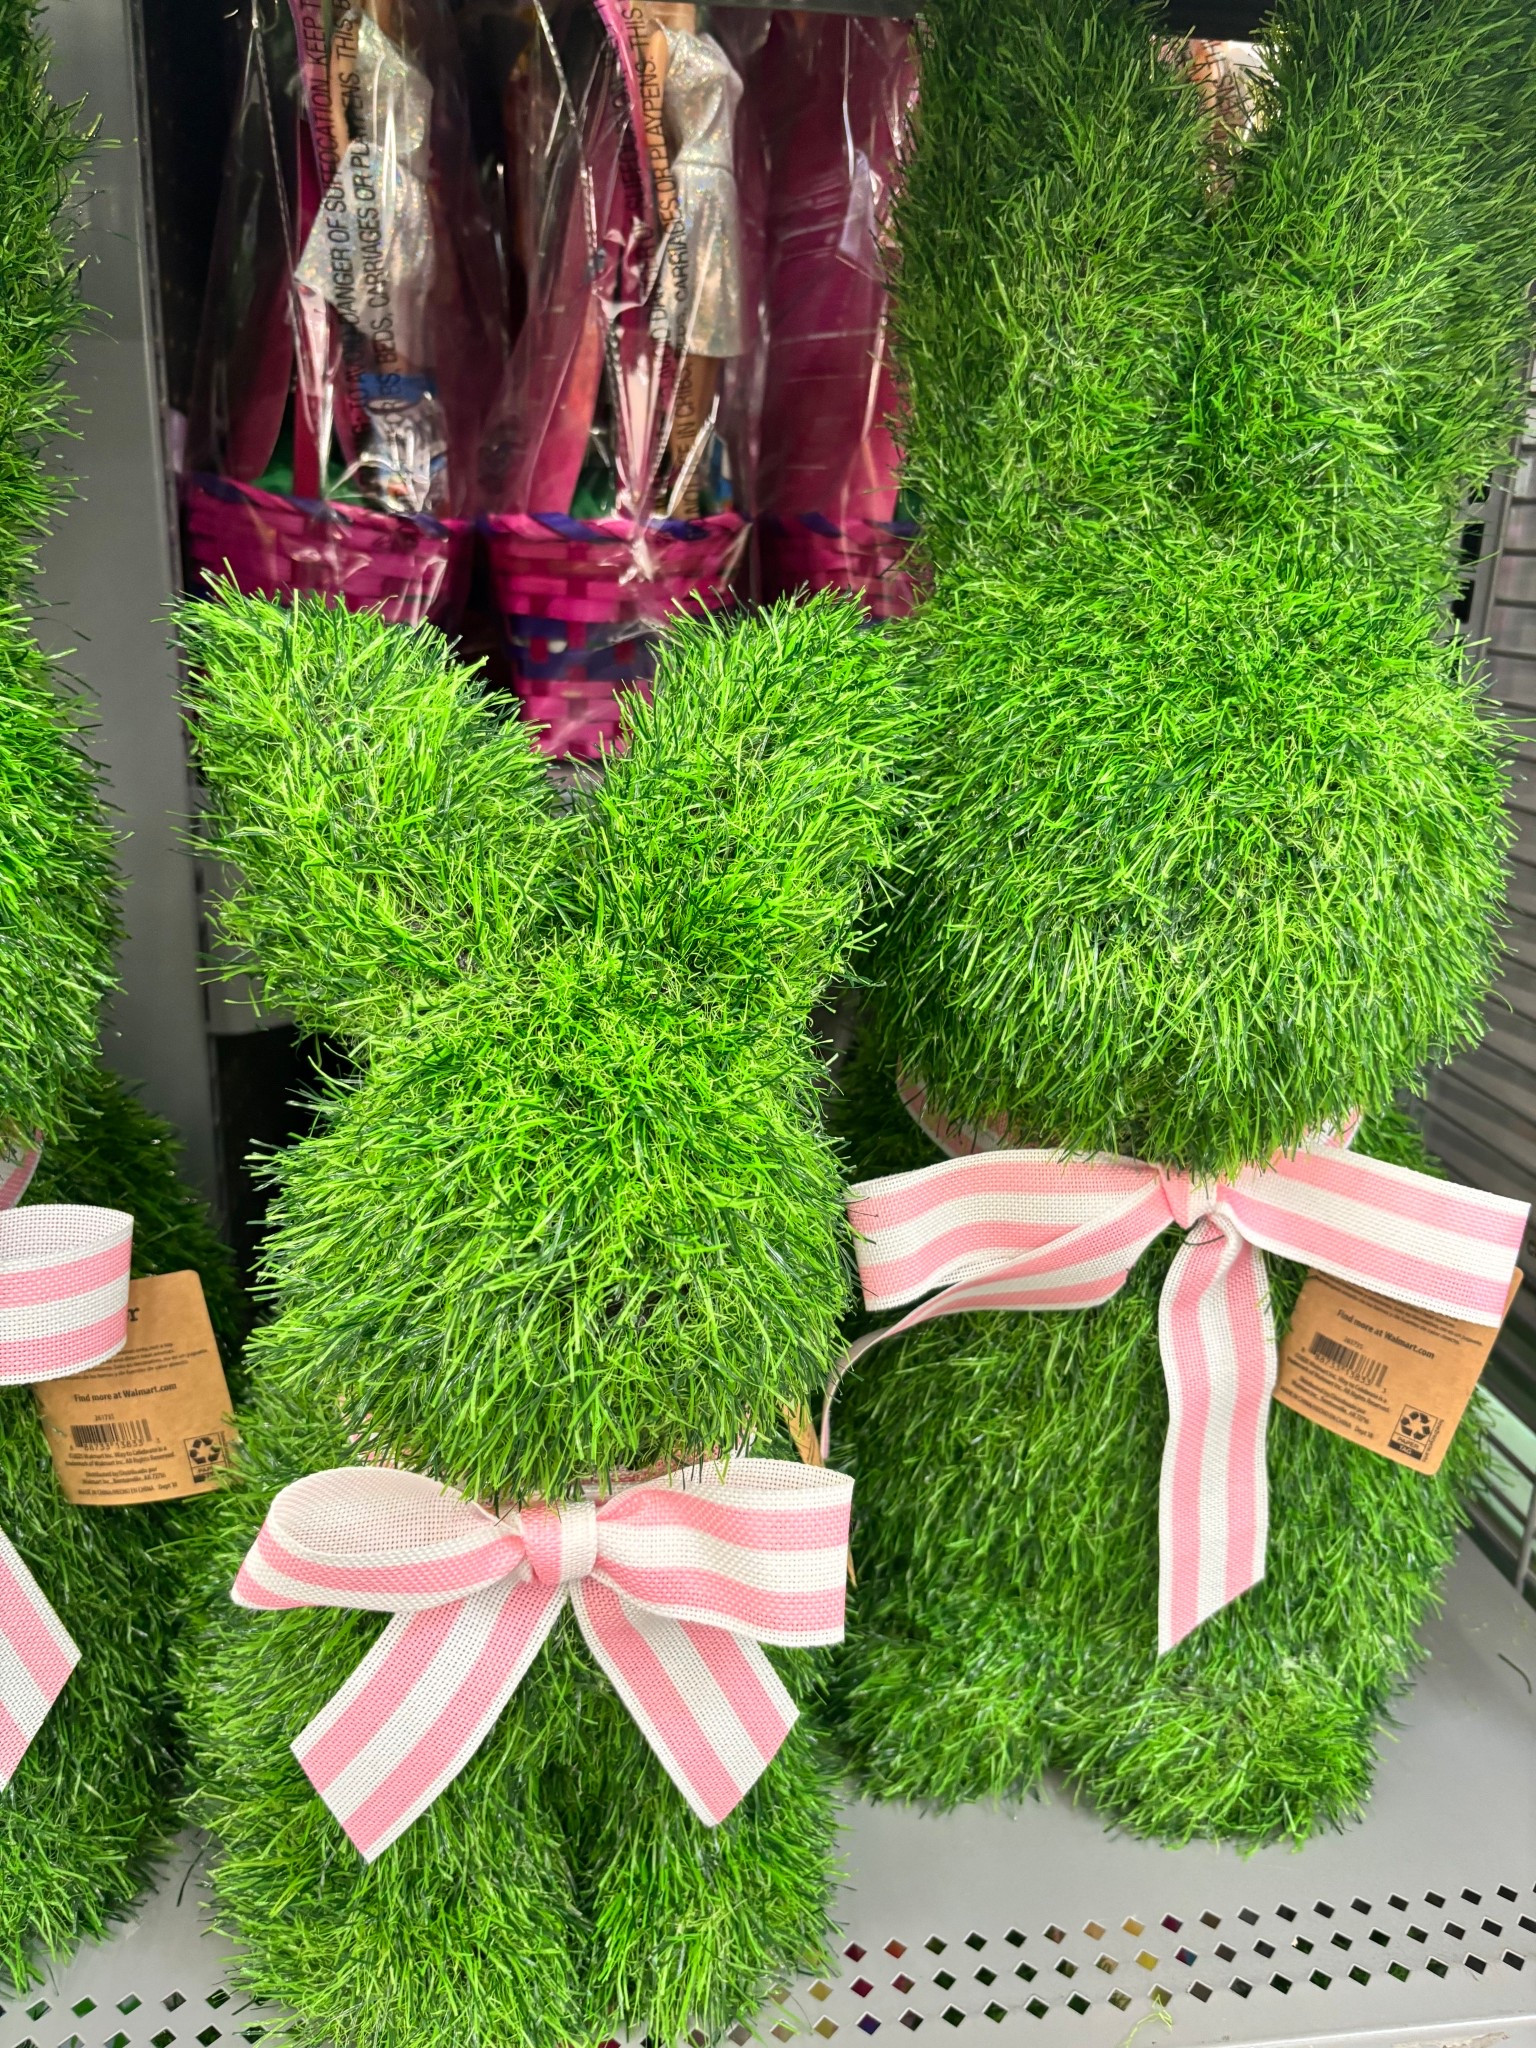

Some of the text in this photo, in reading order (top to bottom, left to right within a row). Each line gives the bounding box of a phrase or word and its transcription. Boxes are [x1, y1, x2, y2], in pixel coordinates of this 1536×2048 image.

[302, 16, 329, 66] KEEP
[333, 18, 358, 60] THIS
[622, 7, 650, 49] THIS
[353, 174, 377, 201] OR
[654, 168, 677, 192] OR
[327, 216, 350, 243] OF
[357, 207, 390, 308] CARRIAGES
[330, 247, 359, 324] DANGER
[1336, 1308, 1436, 1360] Find more at Walmart.com
[73, 1382, 177, 1403] Find more at Walmart.com
[1396, 1436, 1419, 1449] PAPER
[1398, 1444, 1412, 1454] TAG
